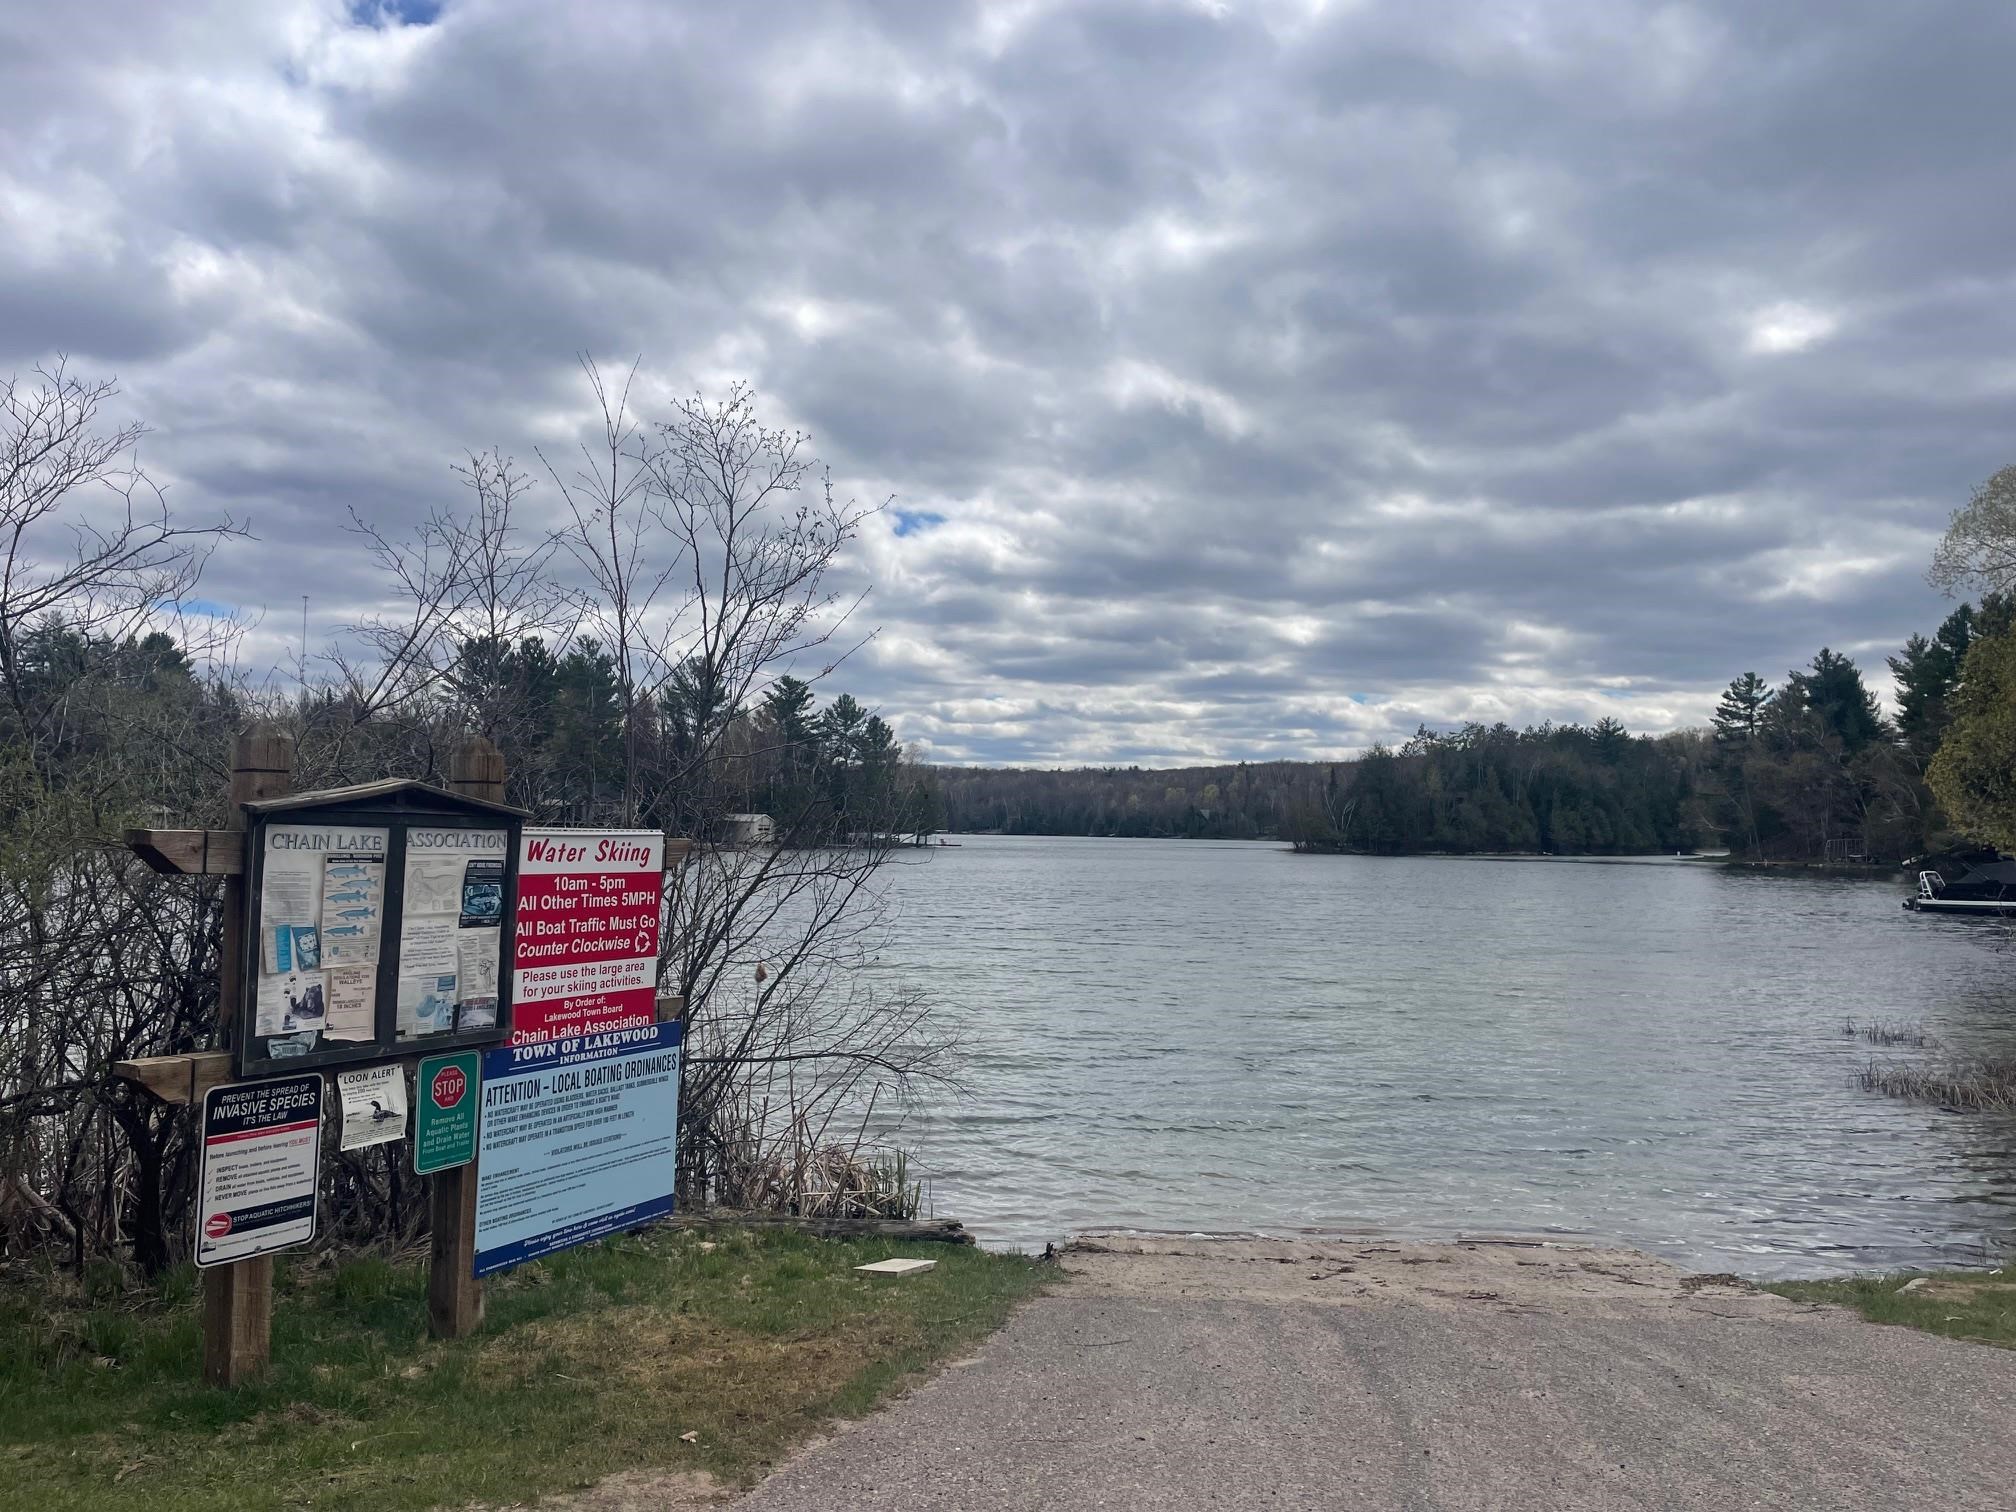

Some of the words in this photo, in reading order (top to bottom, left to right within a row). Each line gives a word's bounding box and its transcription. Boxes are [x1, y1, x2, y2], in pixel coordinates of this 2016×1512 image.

[272, 833, 330, 850] CHAIN
[337, 835, 382, 850] LAKE
[407, 832, 506, 848] ASSOCIATION
[527, 838, 586, 863] Water
[595, 840, 650, 868] Skiing
[554, 876, 588, 891] 10am
[600, 876, 625, 892] 5pm
[518, 896, 537, 911] All
[541, 895, 578, 910] Other
[581, 894, 618, 908] Times
[622, 892, 655, 906] 5MPH
[516, 921, 532, 936] All
[537, 920, 566, 935] Boat
[569, 917, 606, 933] Traffic
[610, 916, 637, 930] Must
[640, 915, 656, 928] Go
[518, 942, 569, 958] Counter
[572, 938, 630, 954] Clockwise
[522, 971, 561, 983] Please
[561, 970, 578, 979] use
[582, 966, 596, 977] the
[600, 964, 622, 976] large
[626, 962, 645, 972] area
[523, 986, 538, 997] for
[541, 984, 563, 998] your
[568, 980, 597, 992] skiing
[600, 975, 643, 989] activities.
[564, 1000, 574, 1010] By
[576, 998, 597, 1007] Order
[597, 996, 606, 1004] of:
[545, 1010, 581, 1022] Lakewood
[583, 1008, 601, 1017] Town
[603, 1004, 623, 1014] Board
[512, 1028, 548, 1045] Chain
[552, 1025, 580, 1039] Lake
[584, 1014, 649, 1034] Association
[513, 1042, 558, 1062] TOWN
[562, 1038, 581, 1053] OF
[584, 1026, 659, 1049] LAKEWOOD
[560, 1047, 618, 1065] INFORMATION
[344, 1073, 368, 1084] LOON
[372, 1068, 395, 1079] ALERT
[486, 1078, 541, 1108] ATTENTION
[552, 1072, 582, 1094] LOCAL
[585, 1064, 622, 1088] BOATING
[625, 1053, 677, 1079] ORDINANCES
[222, 1092, 255, 1104] PREVENT
[257, 1090, 270, 1099] THE
[272, 1086, 298, 1096] SPREAD
[300, 1084, 309, 1092] OF
[435, 1079, 463, 1096] STOP
[213, 1100, 266, 1120] INVASIVE
[270, 1093, 315, 1111] SPECIES
[495, 1106, 519, 1117] WATERCRAFT
[243, 1117, 256, 1126] IT'S
[258, 1114, 271, 1123] THE
[273, 1112, 288, 1120] LAW
[432, 1117, 455, 1126] Remove
[426, 1127, 449, 1137] Aquatic
[494, 1126, 518, 1137] WATERCRAFT
[424, 1138, 434, 1147] and
[436, 1136, 452, 1144] Drain
[493, 1138, 518, 1149] WATERCRAFT
[217, 1165, 238, 1173] INSPECT
[216, 1174, 237, 1182] REMOVE
[216, 1184, 231, 1192] DRAIN
[233, 1215, 249, 1223] STOP
[249, 1209, 274, 1219] AQUATIC
